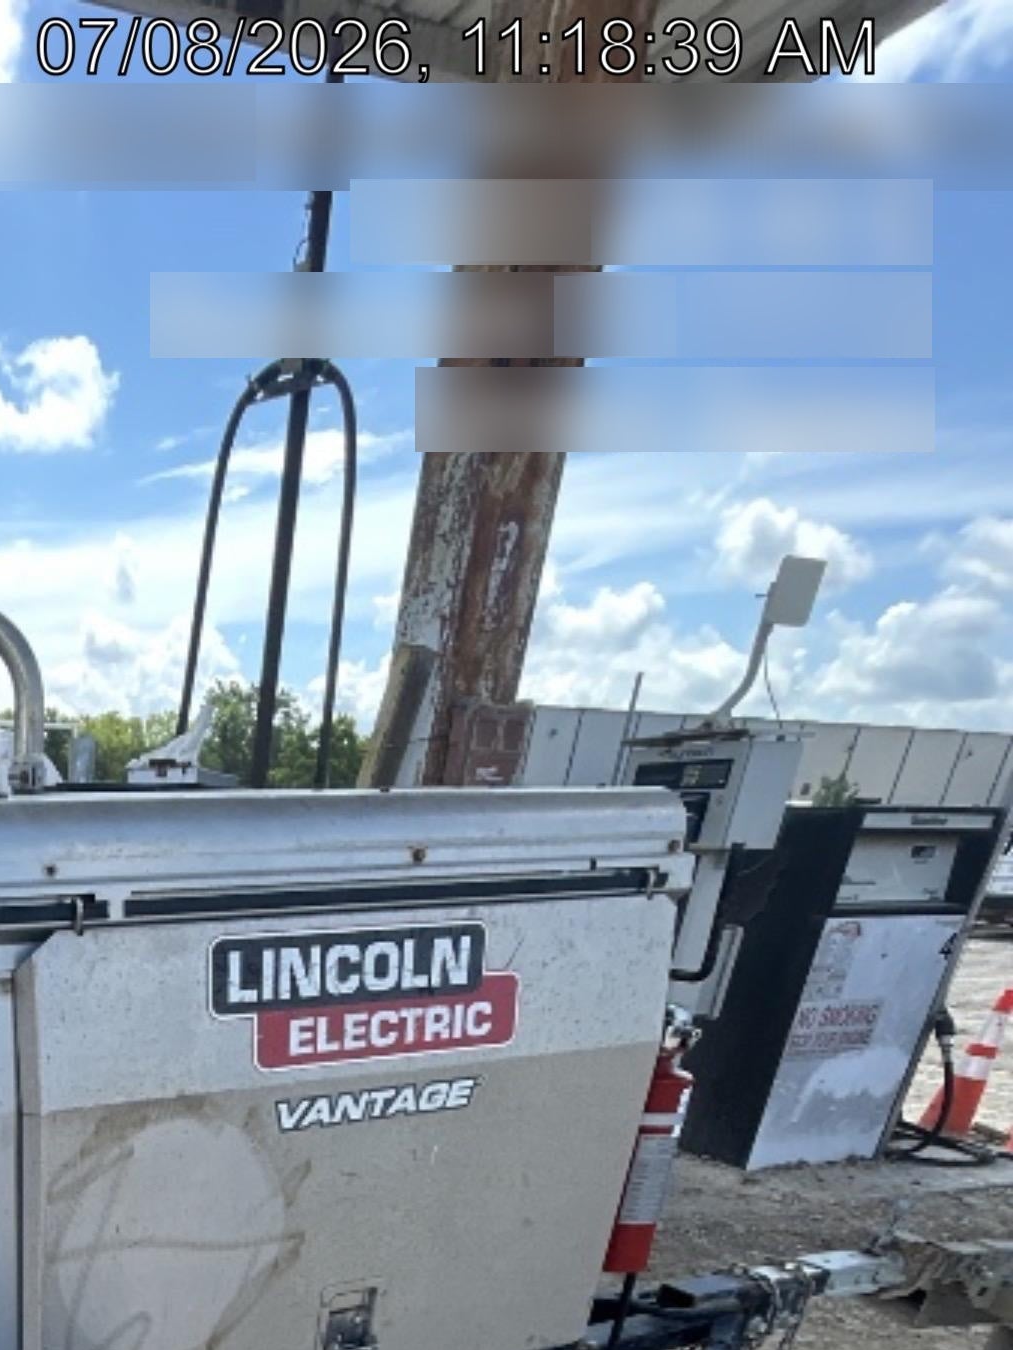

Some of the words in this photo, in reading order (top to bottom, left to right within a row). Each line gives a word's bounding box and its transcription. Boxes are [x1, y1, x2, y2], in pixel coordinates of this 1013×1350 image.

[226, 935, 472, 1004] LINCOLN
[288, 1001, 493, 1057] ELECTRIC
[276, 1077, 478, 1131] VANTAGE
